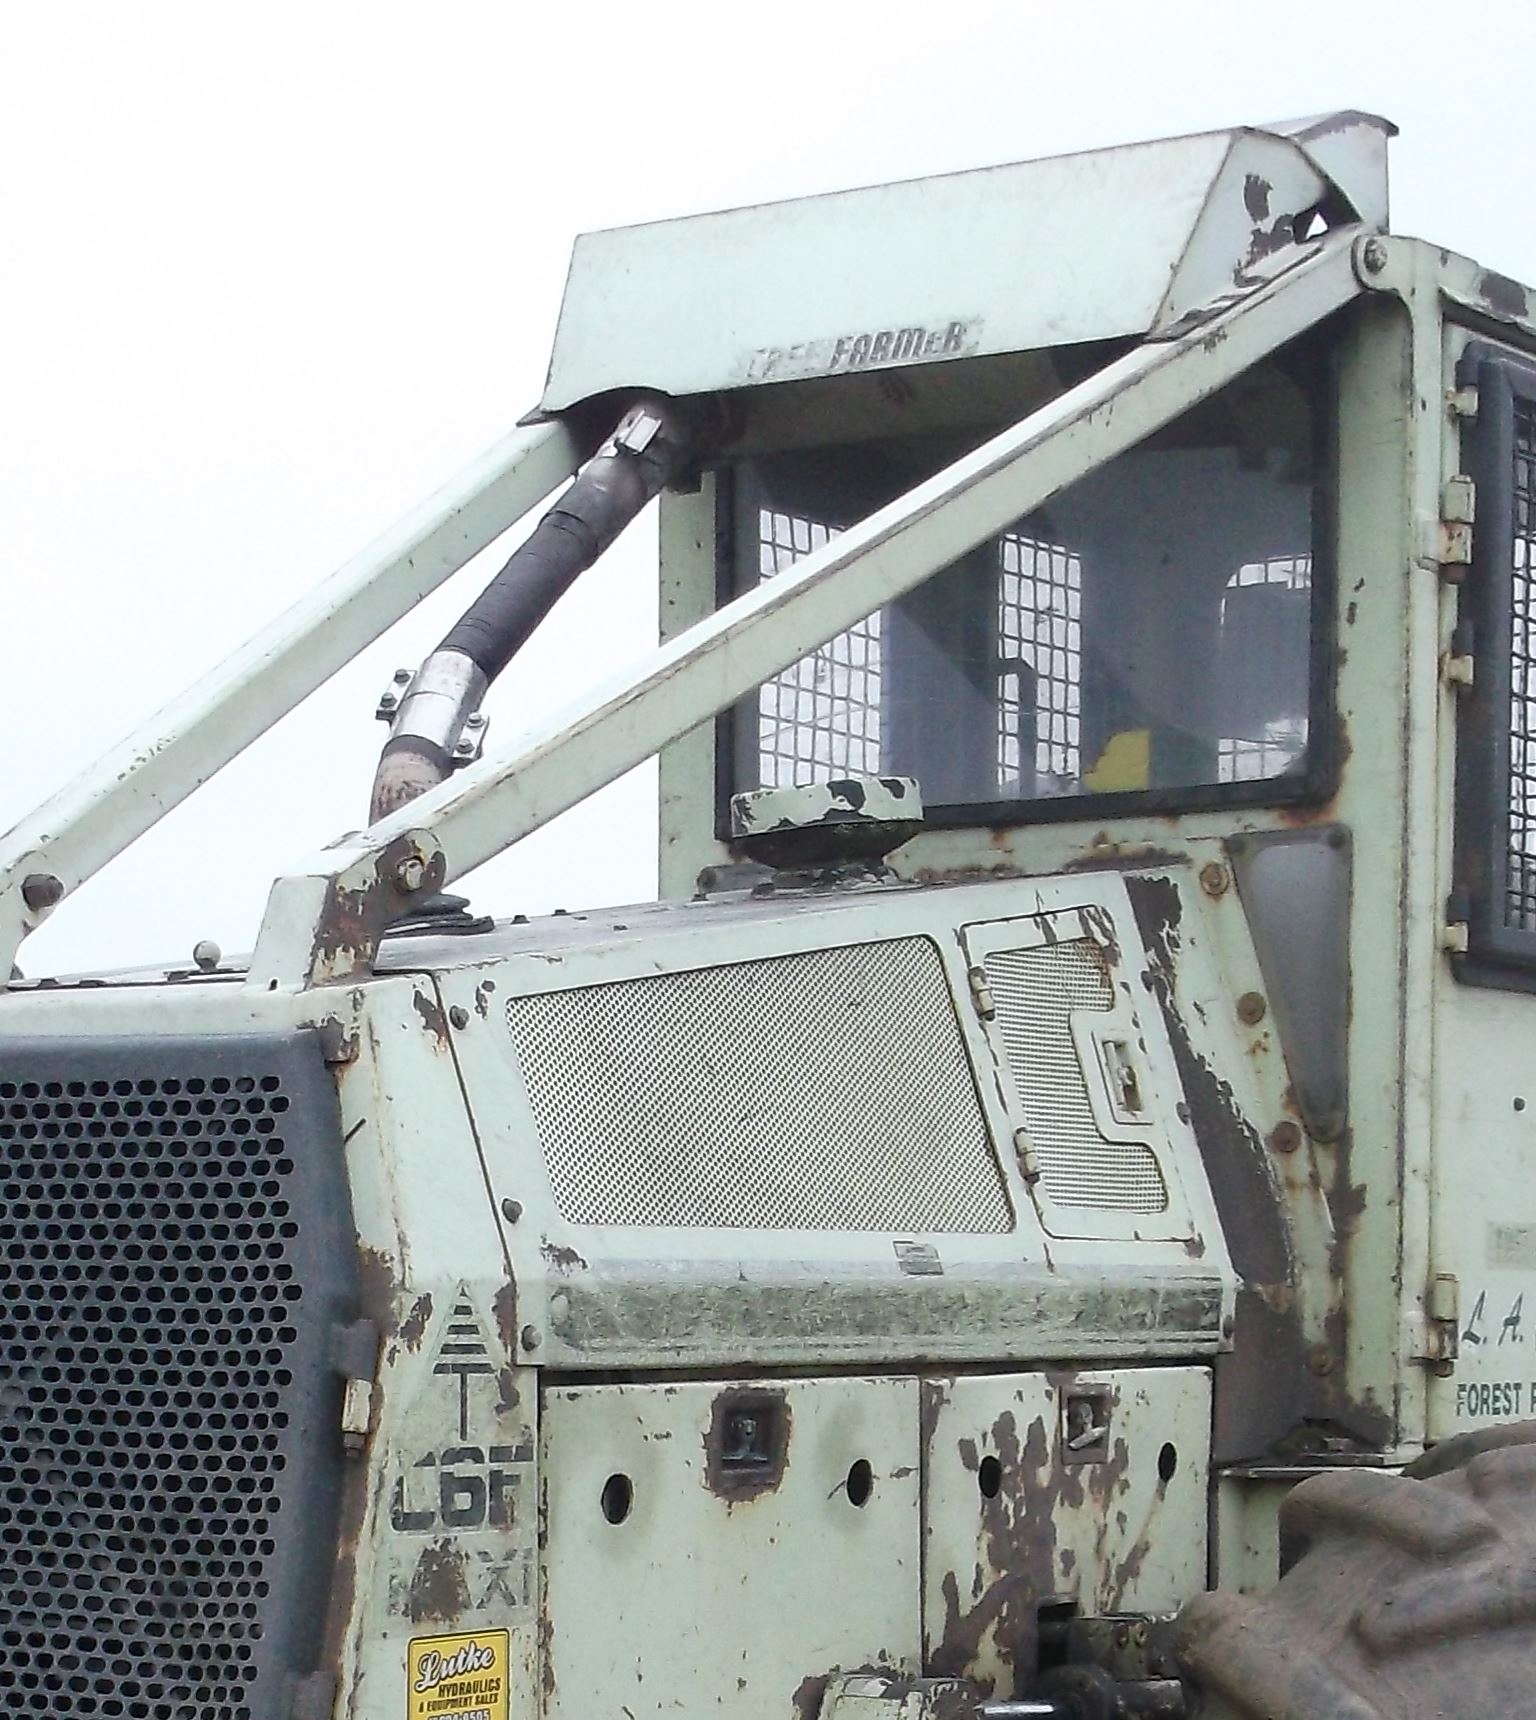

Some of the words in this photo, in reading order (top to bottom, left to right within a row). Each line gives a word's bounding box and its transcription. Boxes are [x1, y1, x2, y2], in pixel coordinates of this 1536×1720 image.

[1498, 1291, 1524, 1346] A.
[1456, 1382, 1522, 1417] FOREST
[414, 1640, 495, 1694] Lutke
[438, 1677, 502, 1698] HYDRAULICS
[474, 1692, 499, 1706] SALES
